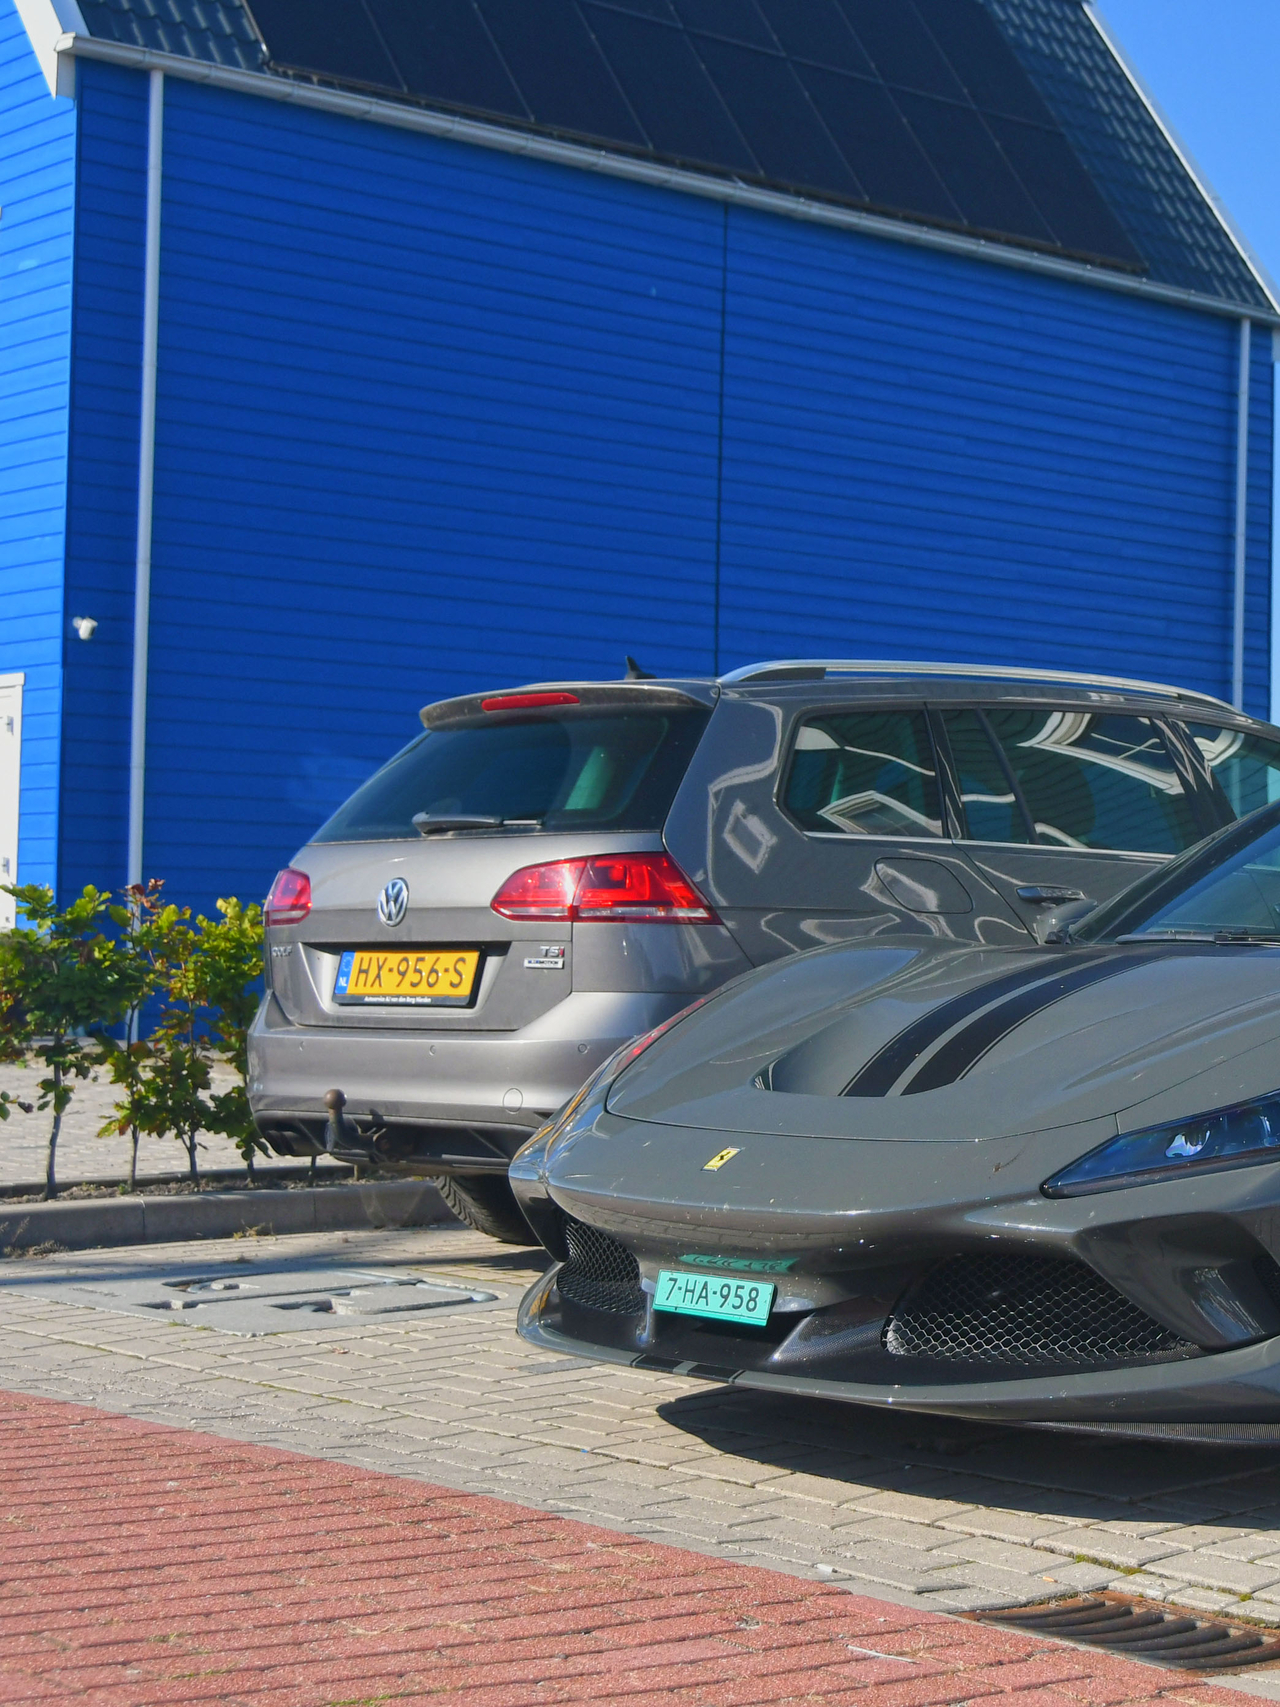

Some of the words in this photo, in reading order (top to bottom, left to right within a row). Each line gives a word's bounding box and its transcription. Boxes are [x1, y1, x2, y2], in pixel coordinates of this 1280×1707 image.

[338, 976, 348, 987] NL
[354, 956, 467, 989] HX-956-S
[665, 1277, 760, 1313] 7-HA-958
